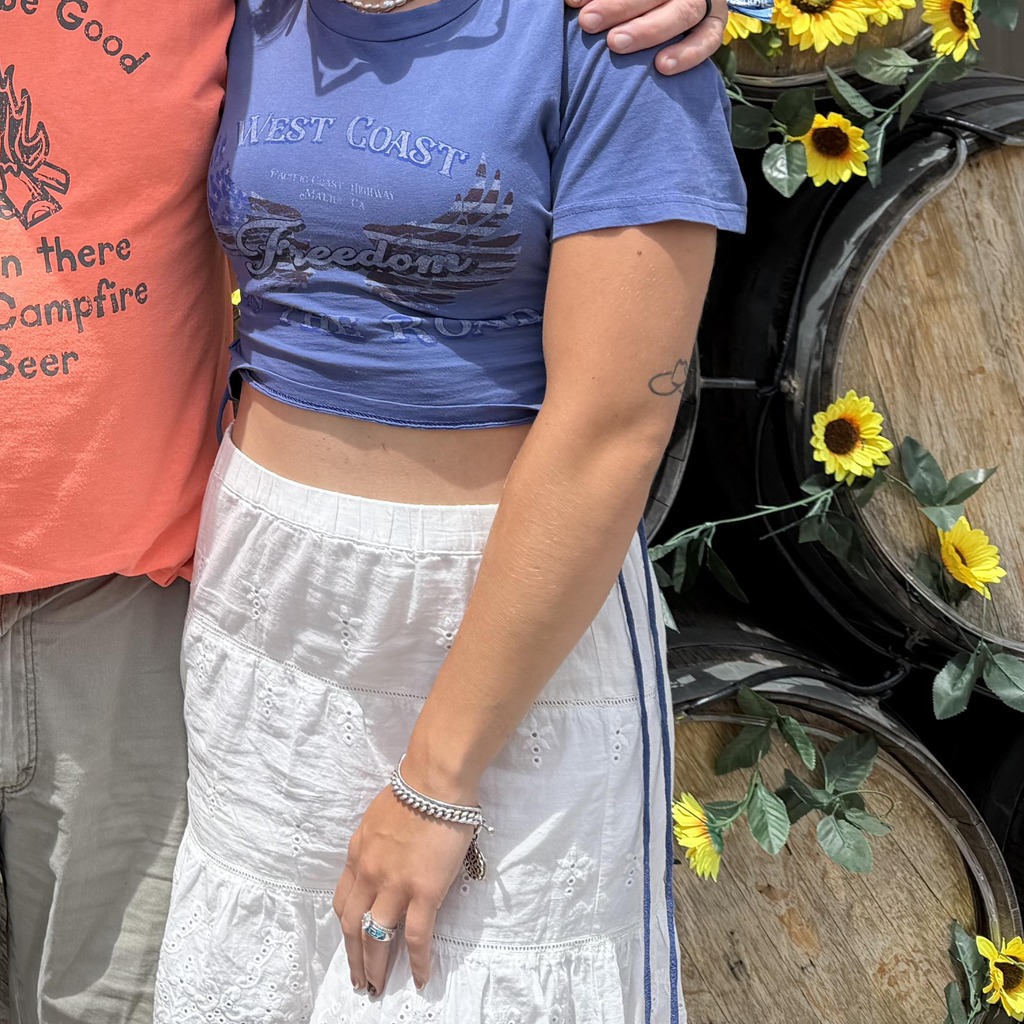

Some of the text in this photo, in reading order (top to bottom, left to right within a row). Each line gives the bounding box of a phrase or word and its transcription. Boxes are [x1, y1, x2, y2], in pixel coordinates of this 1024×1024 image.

[237, 113, 470, 179] WEST COAST
[36, 236, 131, 273] there
[236, 217, 475, 279] Freedom
